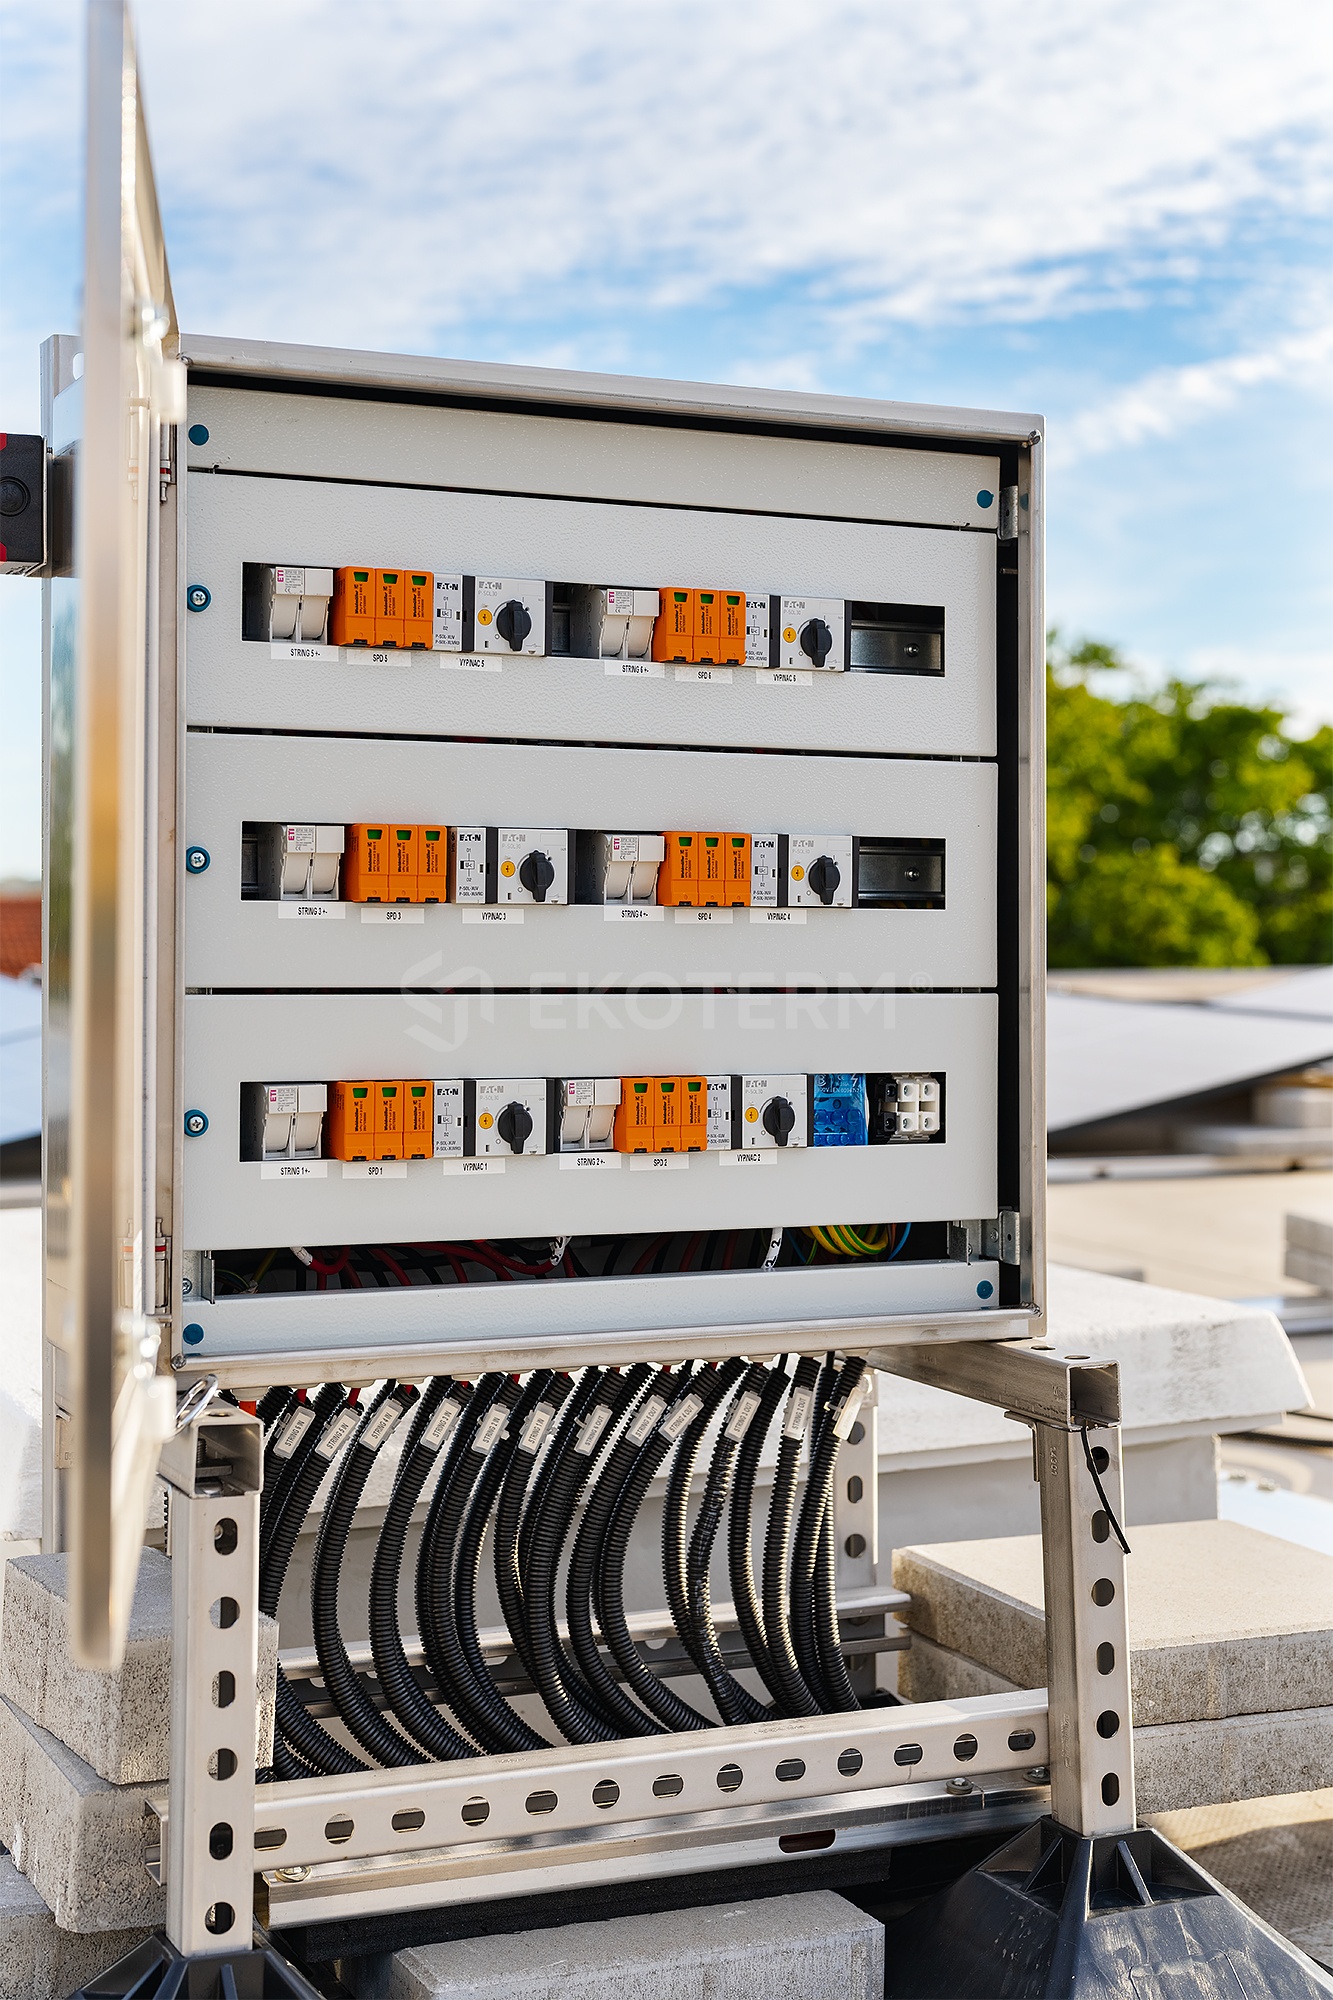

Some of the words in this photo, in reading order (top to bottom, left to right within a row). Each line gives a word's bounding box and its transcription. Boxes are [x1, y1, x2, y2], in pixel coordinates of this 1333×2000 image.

[290, 648, 310, 657] STRING
[372, 654, 384, 662] SPD
[622, 665, 640, 673] STRING
[298, 907, 317, 915] STRING
[386, 912, 397, 920] SPD
[621, 910, 639, 918] STRING
[280, 1166, 300, 1175] STRING
[577, 1158, 596, 1166] STRING
[368, 1167, 379, 1175] SPD
[635, 1419, 649, 1437] STRING
[648, 1406, 657, 1417] OUT
[669, 1416, 684, 1432] STRING
[684, 1404, 694, 1415] OUT
[734, 1415, 746, 1432] STRING
[743, 1402, 752, 1412] OUT
[792, 1412, 802, 1429] STRING
[798, 1397, 806, 1408] OUT
[371, 1421, 386, 1439] STRING
[432, 1420, 446, 1437] STRING
[482, 1426, 496, 1443] STRING
[528, 1426, 540, 1444] STRING
[585, 1429, 597, 1446] STRING
[595, 1415, 604, 1426] OUT
[284, 1429, 299, 1446] STRING
[326, 1431, 342, 1449] STRING
